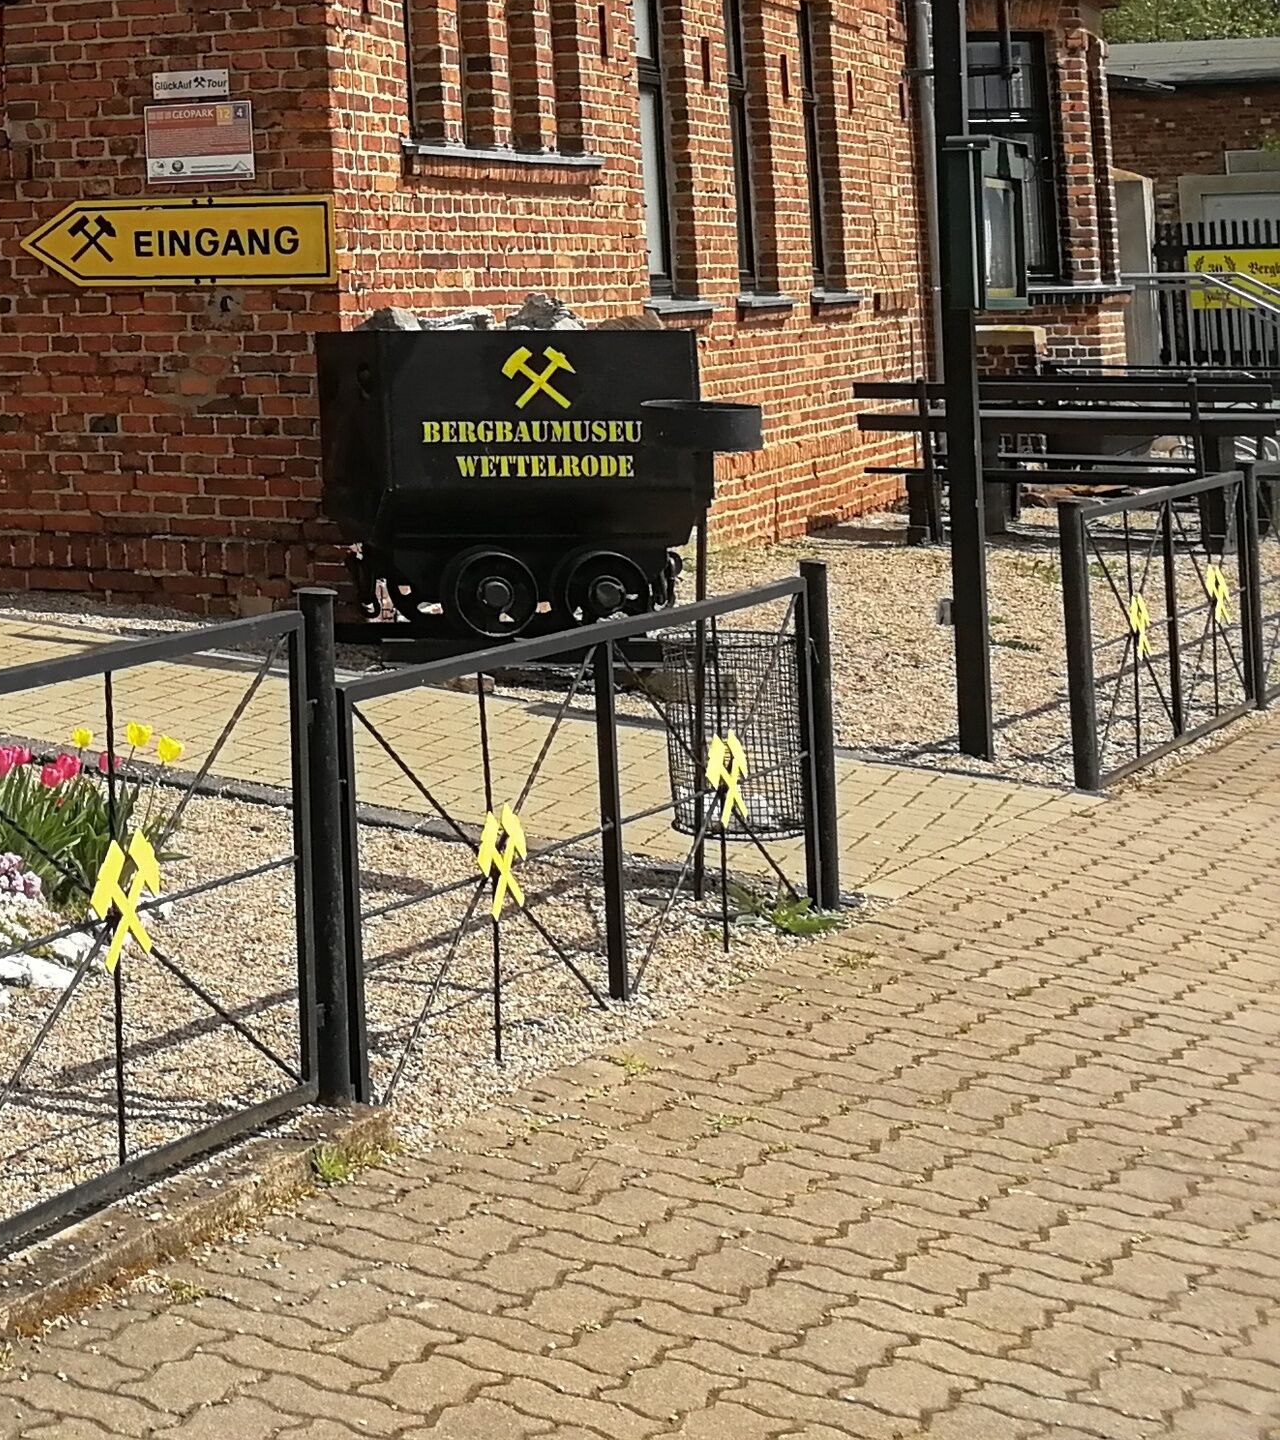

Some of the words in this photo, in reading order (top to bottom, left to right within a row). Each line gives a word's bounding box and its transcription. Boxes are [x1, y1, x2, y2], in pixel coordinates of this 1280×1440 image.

[207, 78, 227, 88] Tour
[172, 108, 214, 119] GEOPARK
[134, 226, 300, 257] EINGANG
[422, 420, 642, 443] BERGBAUMUSEU
[456, 455, 634, 477] WETTELRODE
